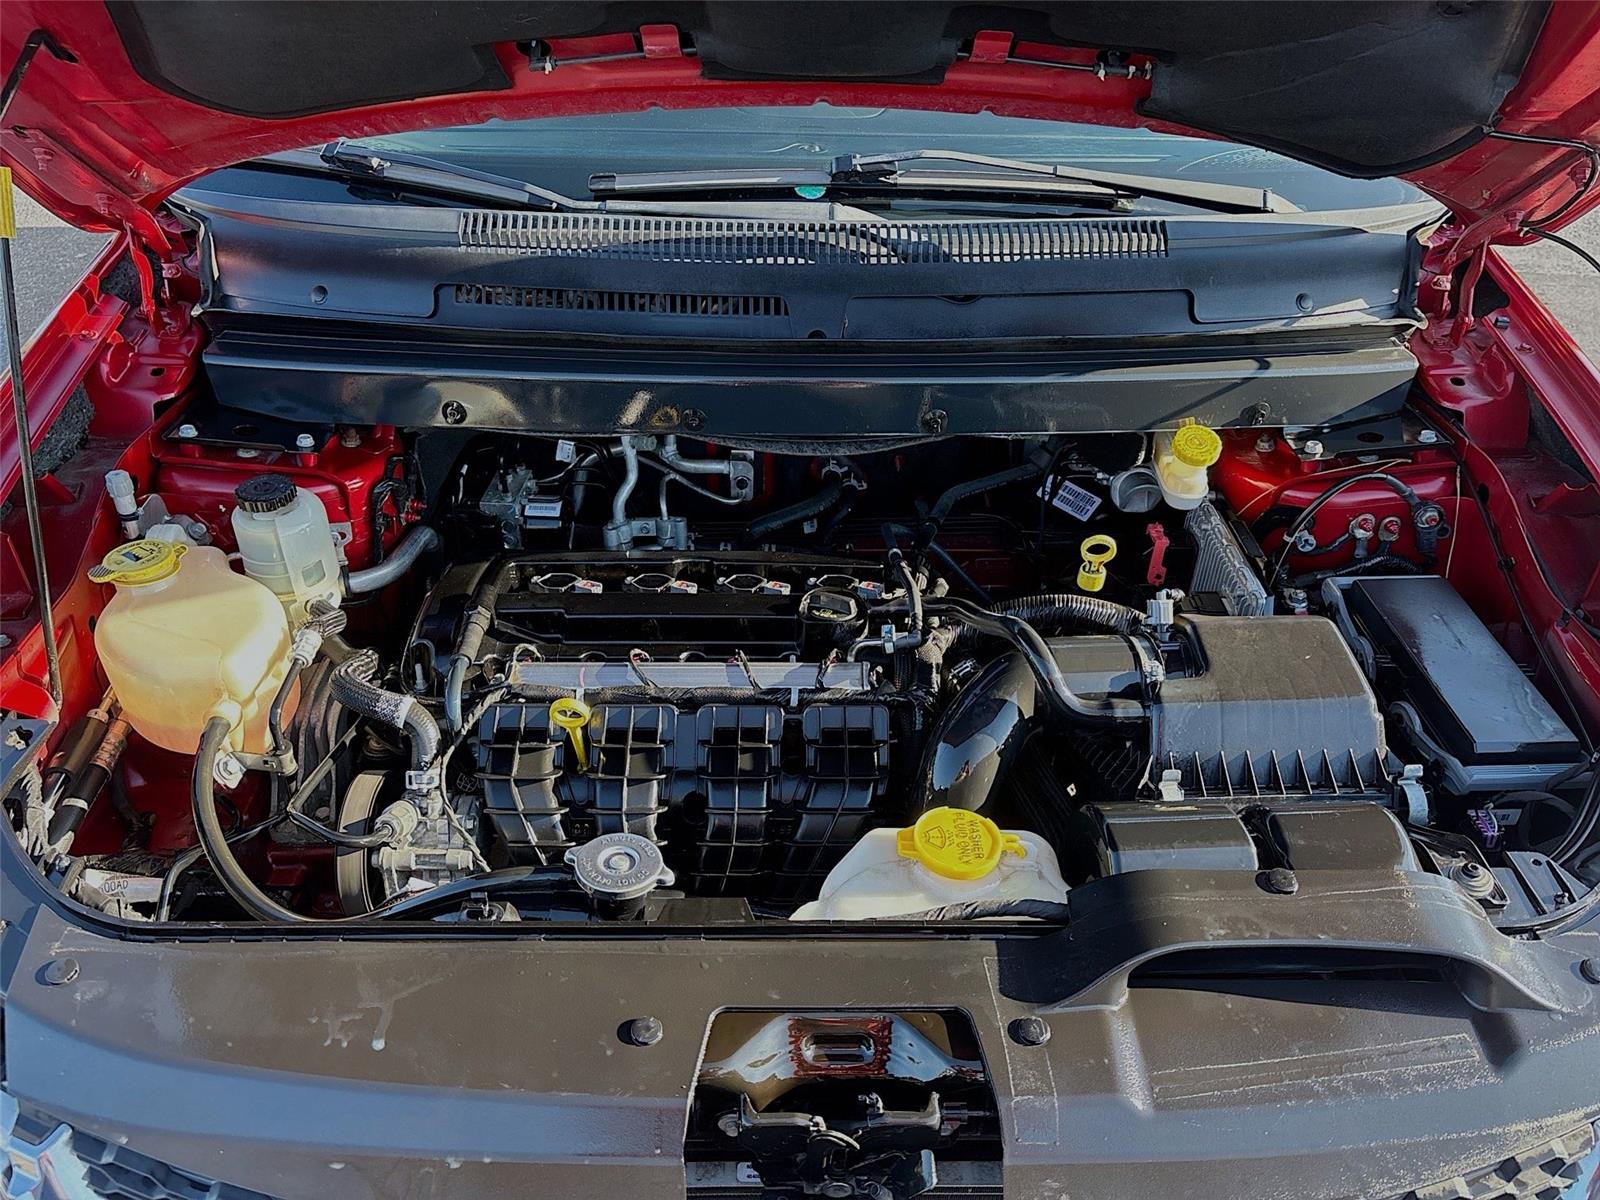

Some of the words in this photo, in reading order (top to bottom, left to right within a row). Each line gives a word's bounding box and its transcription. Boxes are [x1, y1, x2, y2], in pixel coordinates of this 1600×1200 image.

[952, 812, 969, 839] FLUID
[967, 818, 985, 860] WASHER
[956, 839, 973, 865] ONLY
[590, 870, 612, 886] OPEN
[617, 877, 636, 887] NOT
[637, 869, 650, 880] DO
